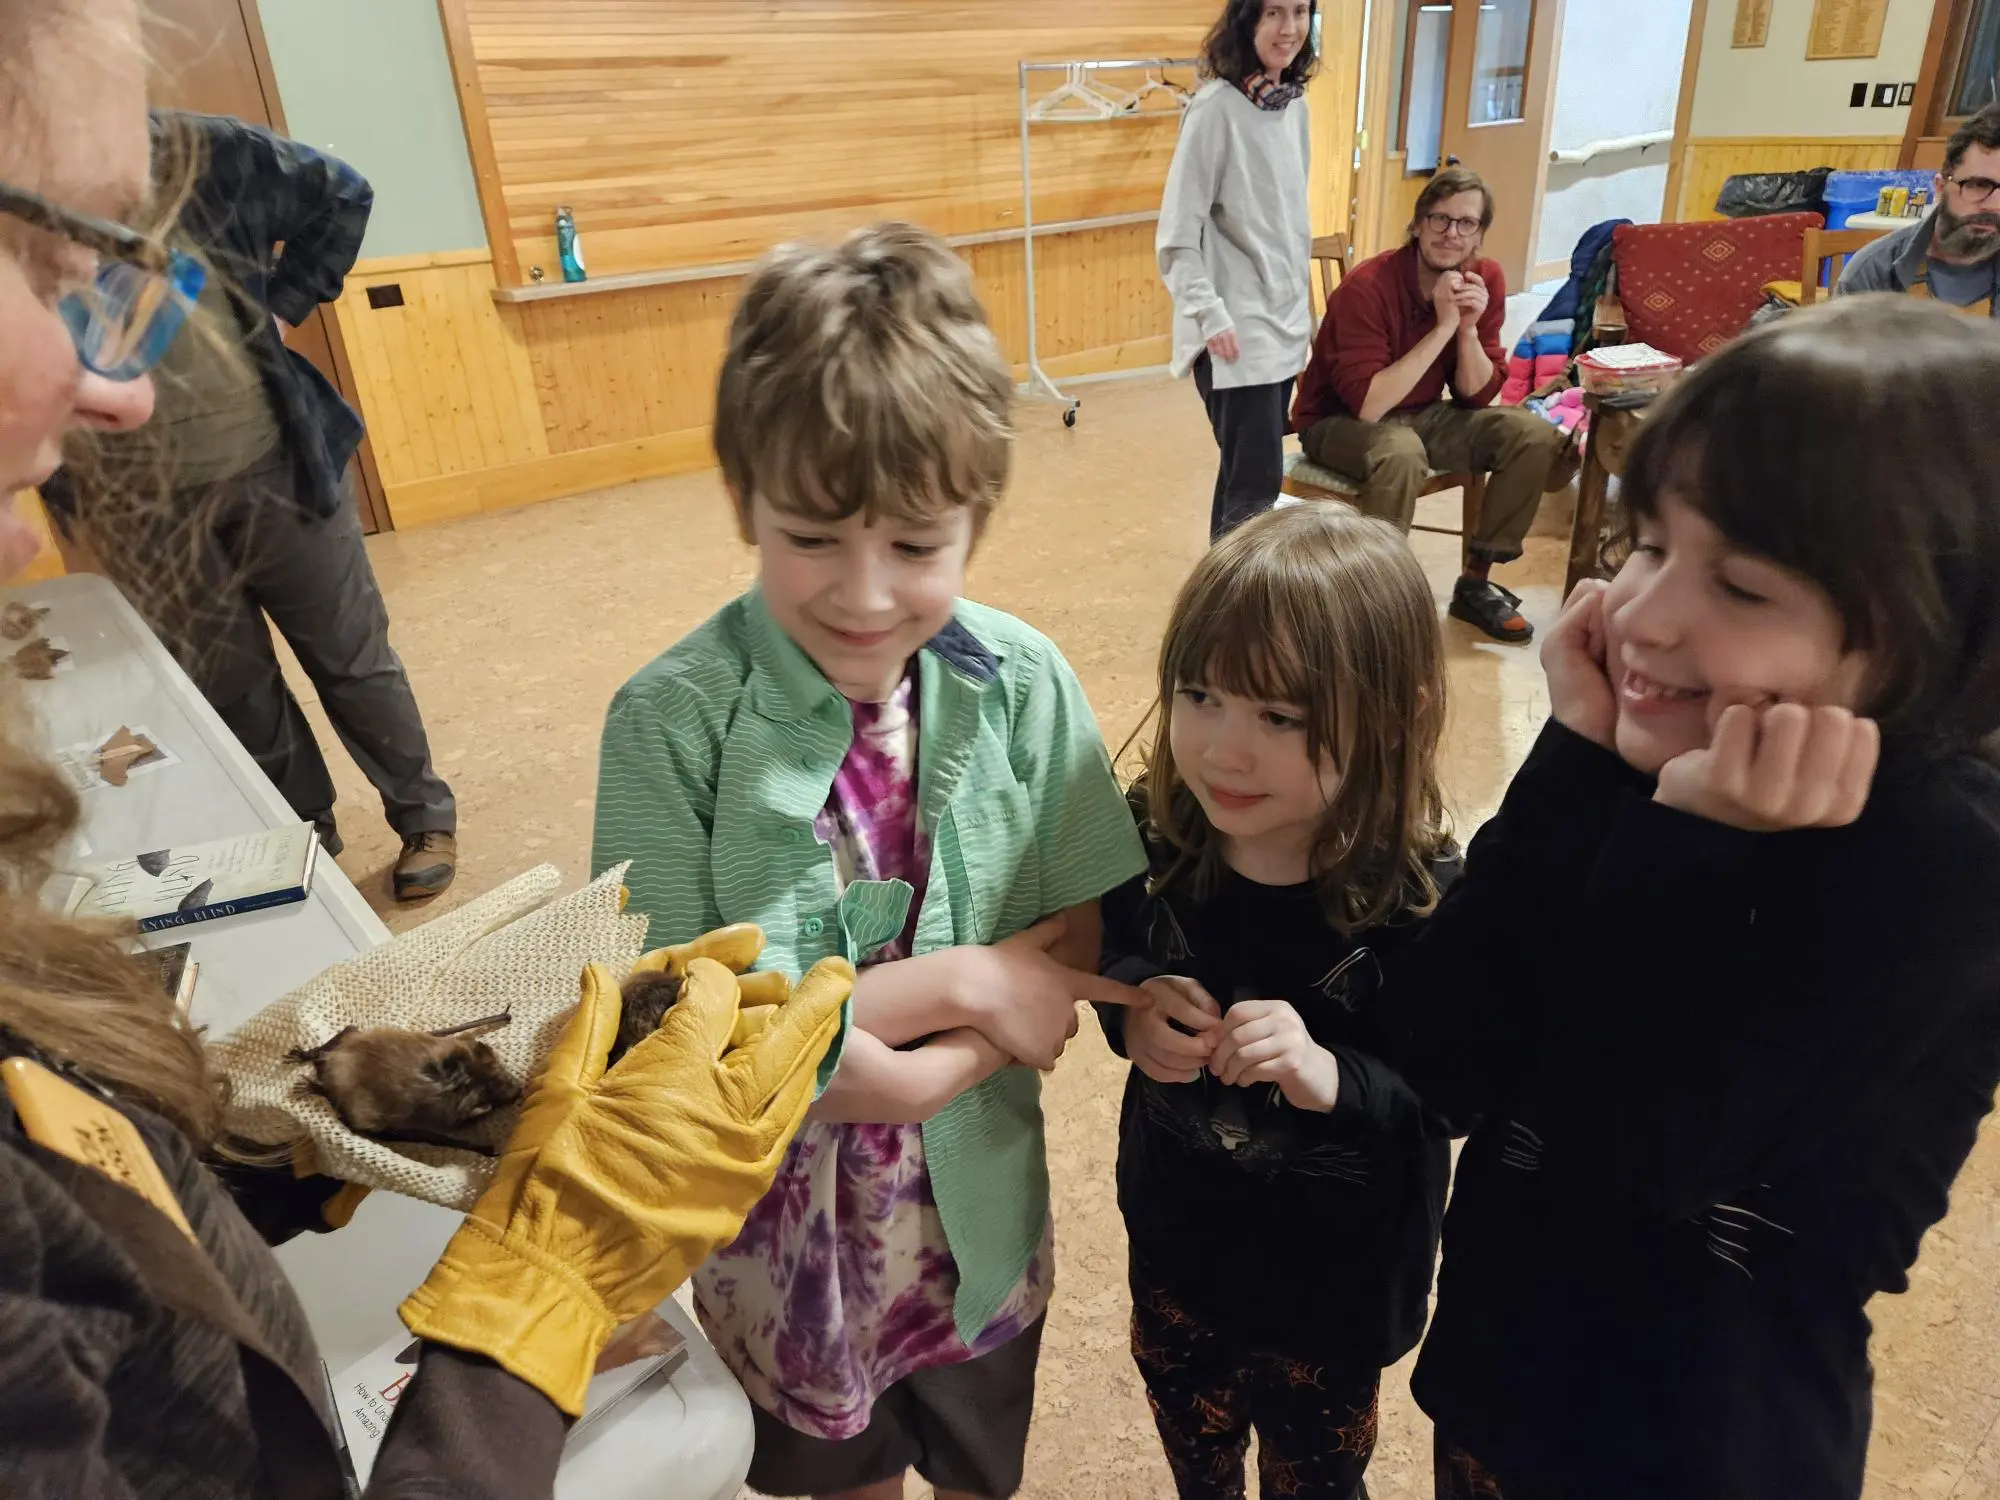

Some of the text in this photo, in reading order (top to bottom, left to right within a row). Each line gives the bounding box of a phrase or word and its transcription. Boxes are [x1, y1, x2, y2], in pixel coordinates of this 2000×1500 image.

[194, 904, 236, 921] BLIND
[354, 1382, 371, 1400] How
[367, 1397, 377, 1408] to
[352, 1407, 381, 1439] Amazing
